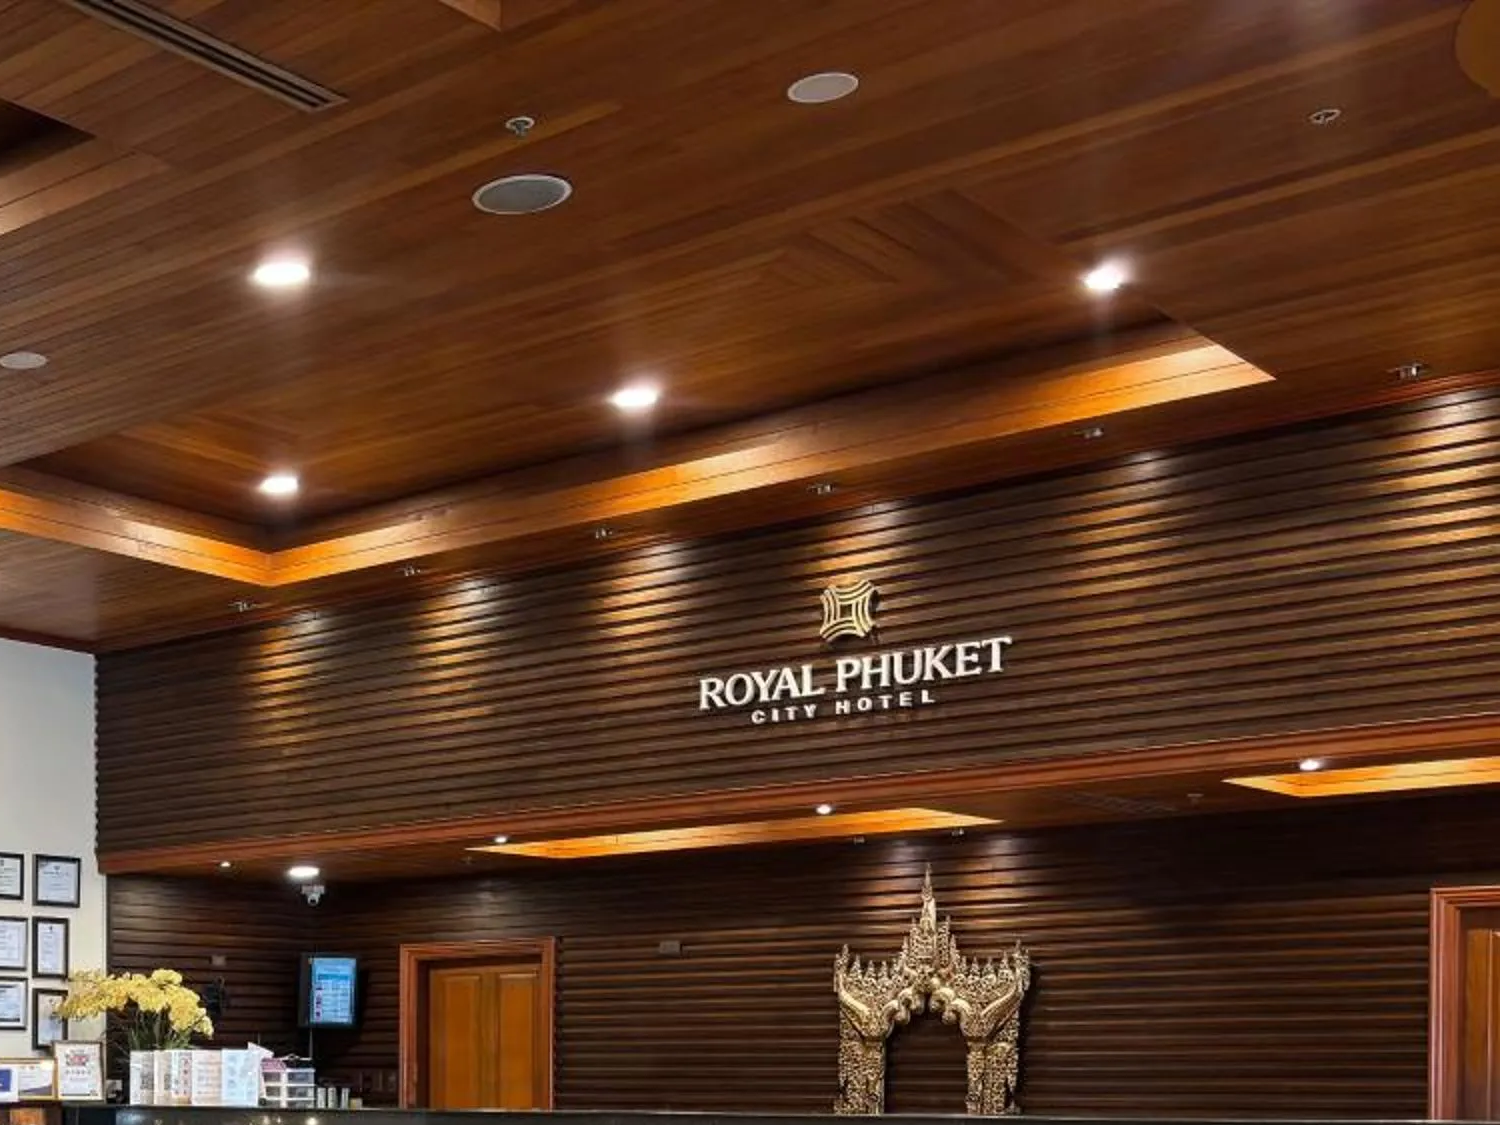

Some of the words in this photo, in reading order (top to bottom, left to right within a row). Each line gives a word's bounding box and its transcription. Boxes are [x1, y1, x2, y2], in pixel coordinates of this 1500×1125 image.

[699, 664, 826, 710] ROYAL
[835, 636, 1012, 692] PHUKET
[751, 703, 817, 725] CITY
[835, 689, 935, 715] HOTEL
